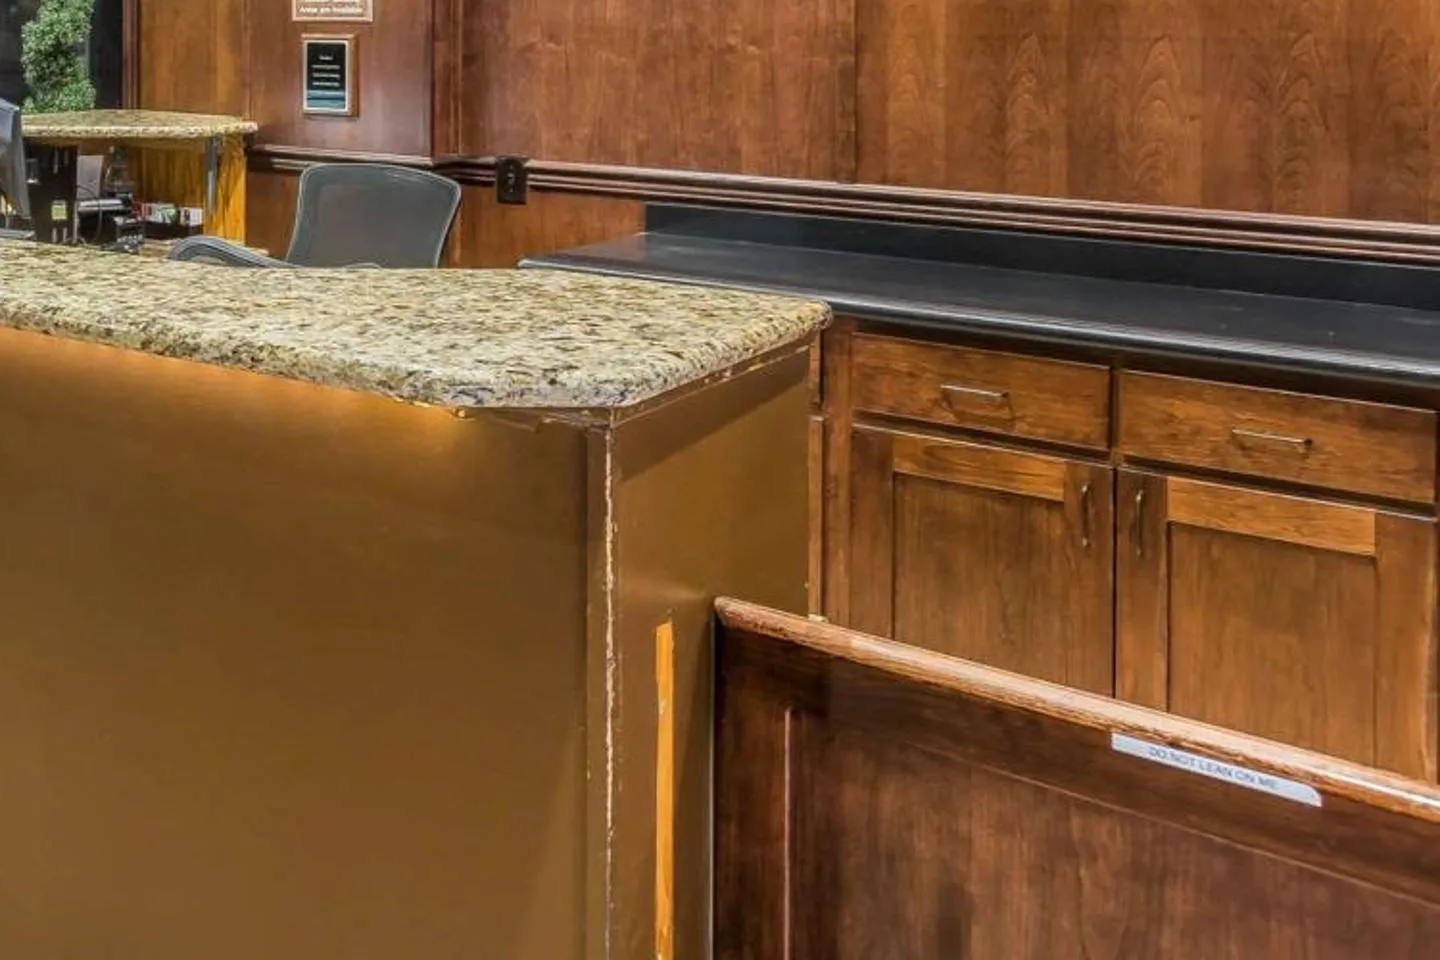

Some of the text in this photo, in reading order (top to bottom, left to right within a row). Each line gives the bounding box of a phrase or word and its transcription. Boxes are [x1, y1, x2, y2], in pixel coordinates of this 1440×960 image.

[1148, 746, 1168, 760] DO
[1169, 750, 1196, 768] NOT
[1198, 759, 1234, 778] LEAN
[1235, 769, 1256, 785] ON
